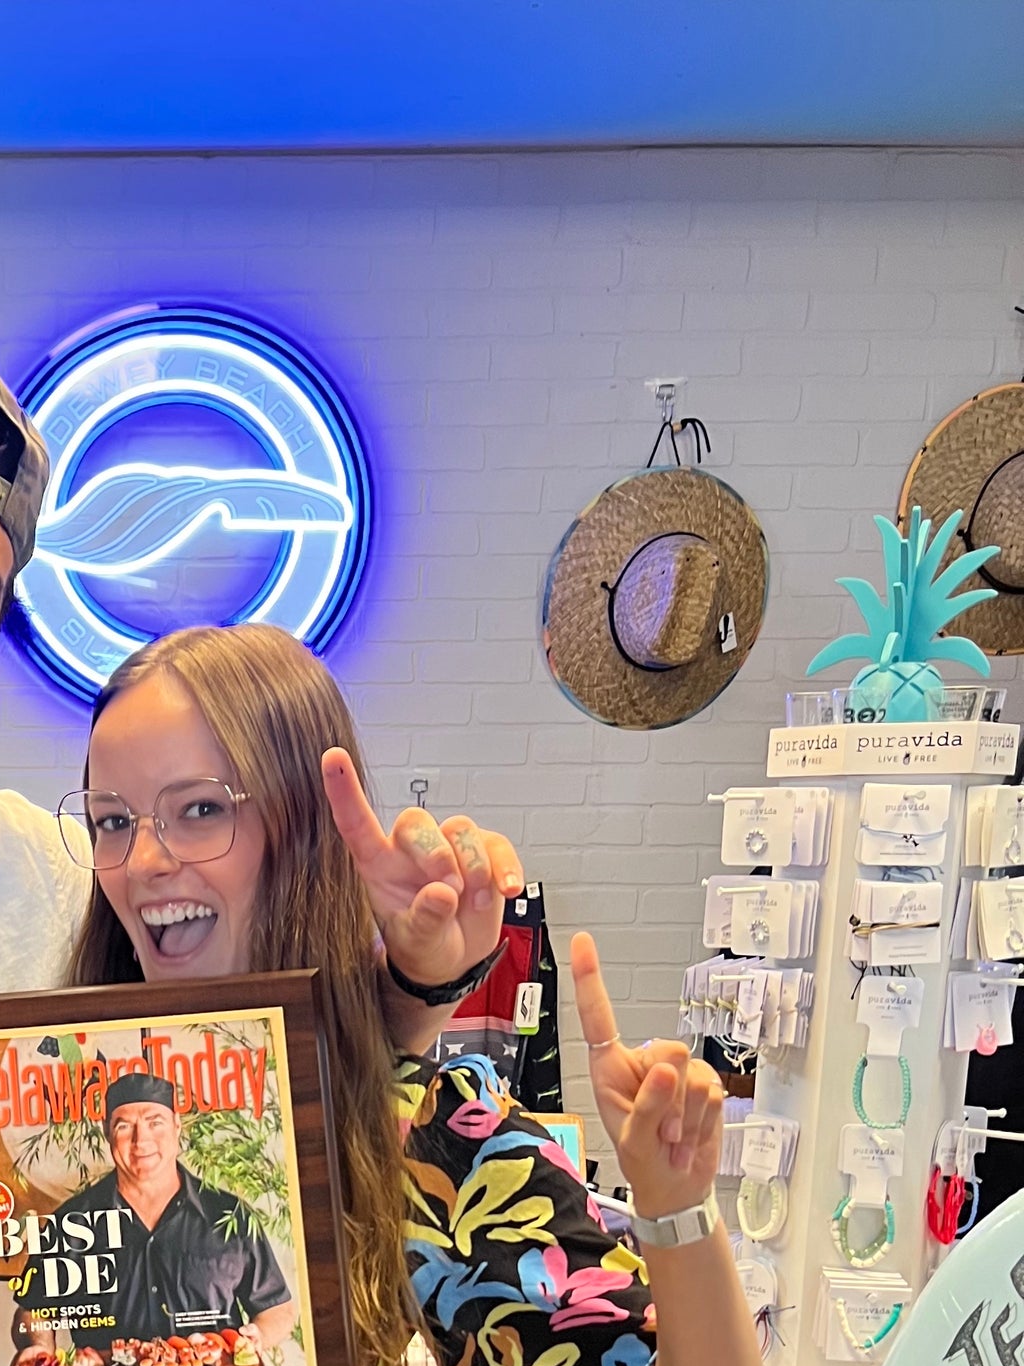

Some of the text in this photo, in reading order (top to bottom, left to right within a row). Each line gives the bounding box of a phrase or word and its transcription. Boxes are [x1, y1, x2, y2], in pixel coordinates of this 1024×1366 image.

[45, 353, 315, 457] DEWEY BEACH
[775, 735, 839, 756] puravida
[856, 731, 964, 752] puravida
[979, 732, 1015, 751] puravida
[878, 754, 938, 763] LIVE FREE
[7, 1252, 119, 1298] of DE
[30, 1303, 102, 1320] HOT SPOTS
[18, 1315, 117, 1333] & HIDDEN GEMS
